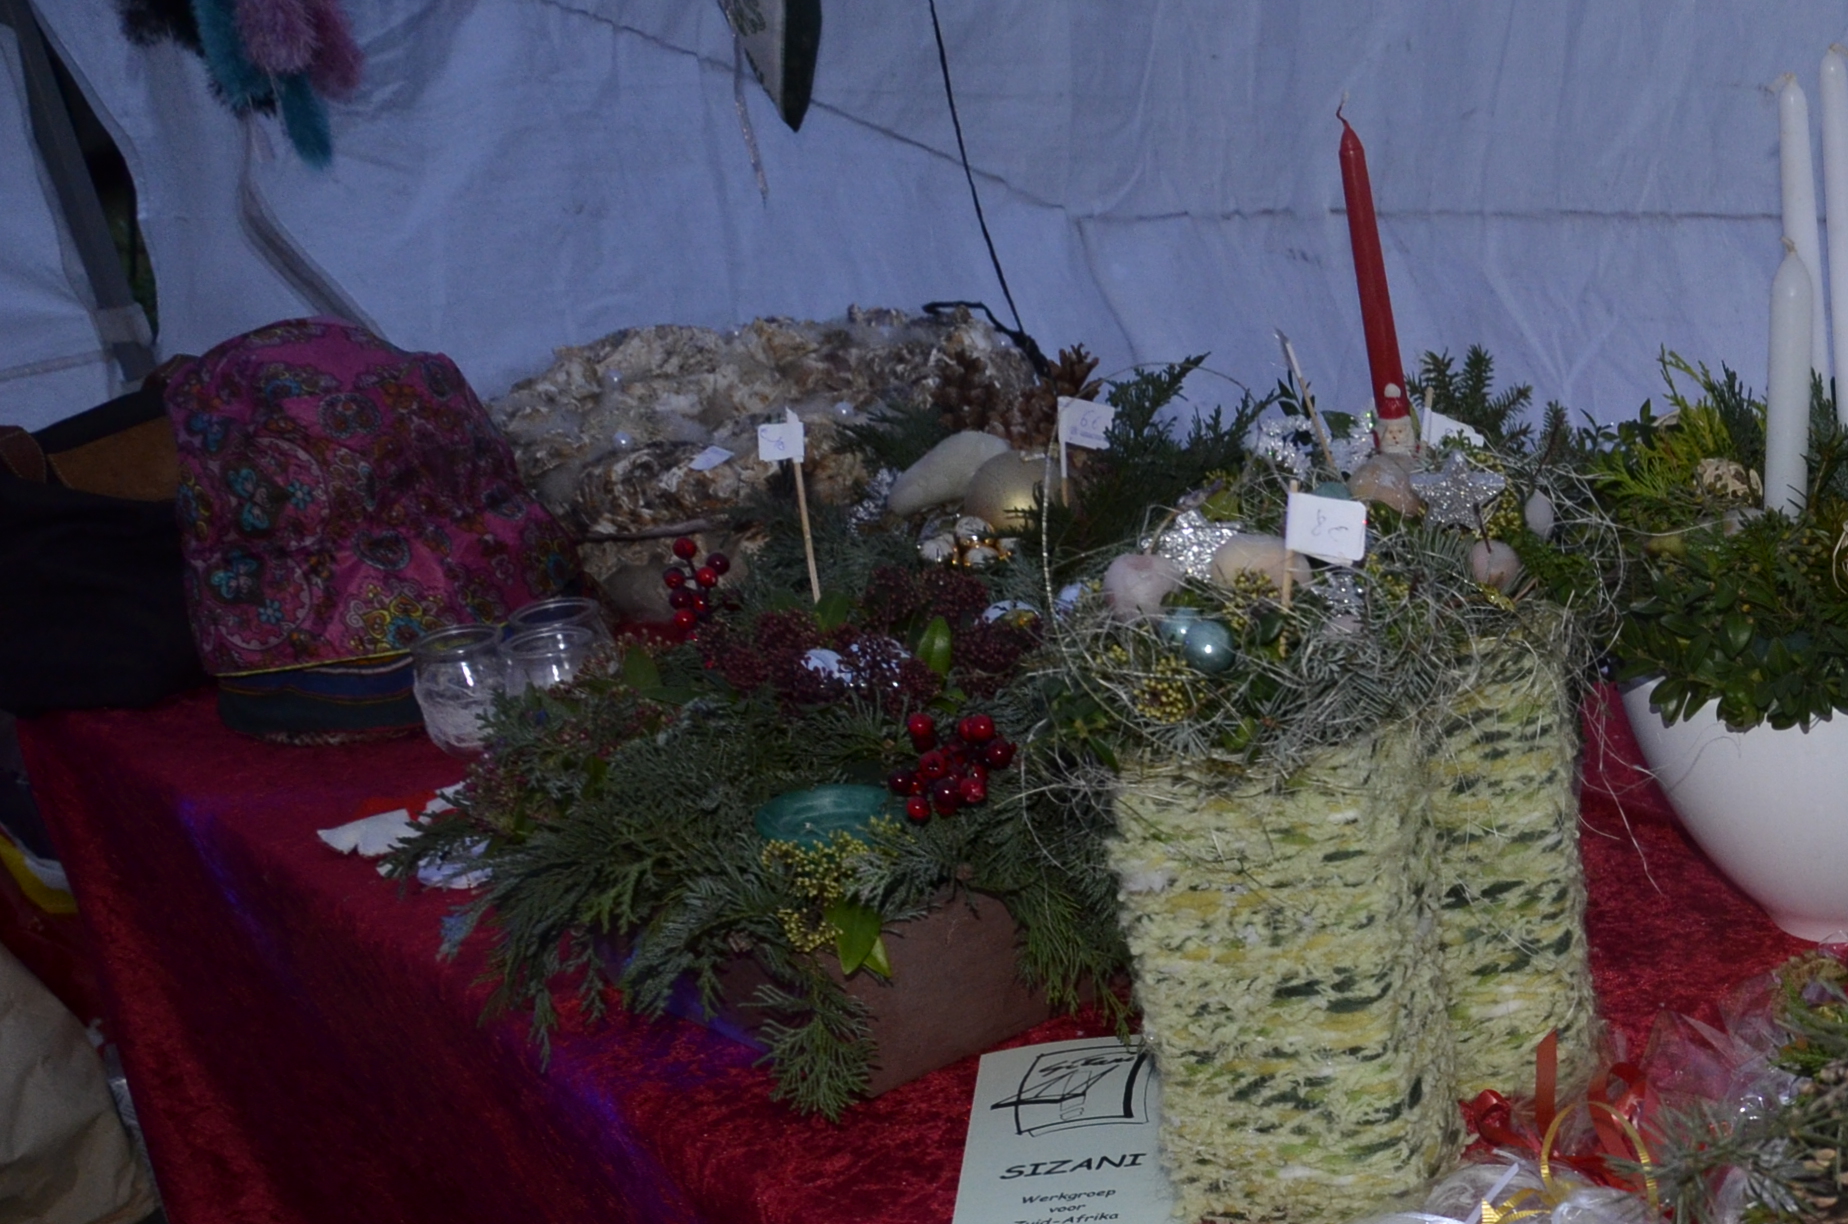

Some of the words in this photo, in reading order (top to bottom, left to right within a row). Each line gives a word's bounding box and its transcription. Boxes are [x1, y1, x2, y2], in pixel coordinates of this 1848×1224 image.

[999, 1153, 1147, 1179] SIZANI
[1022, 1189, 1116, 1204] Werkgroep
[1049, 1204, 1086, 1213] voor
